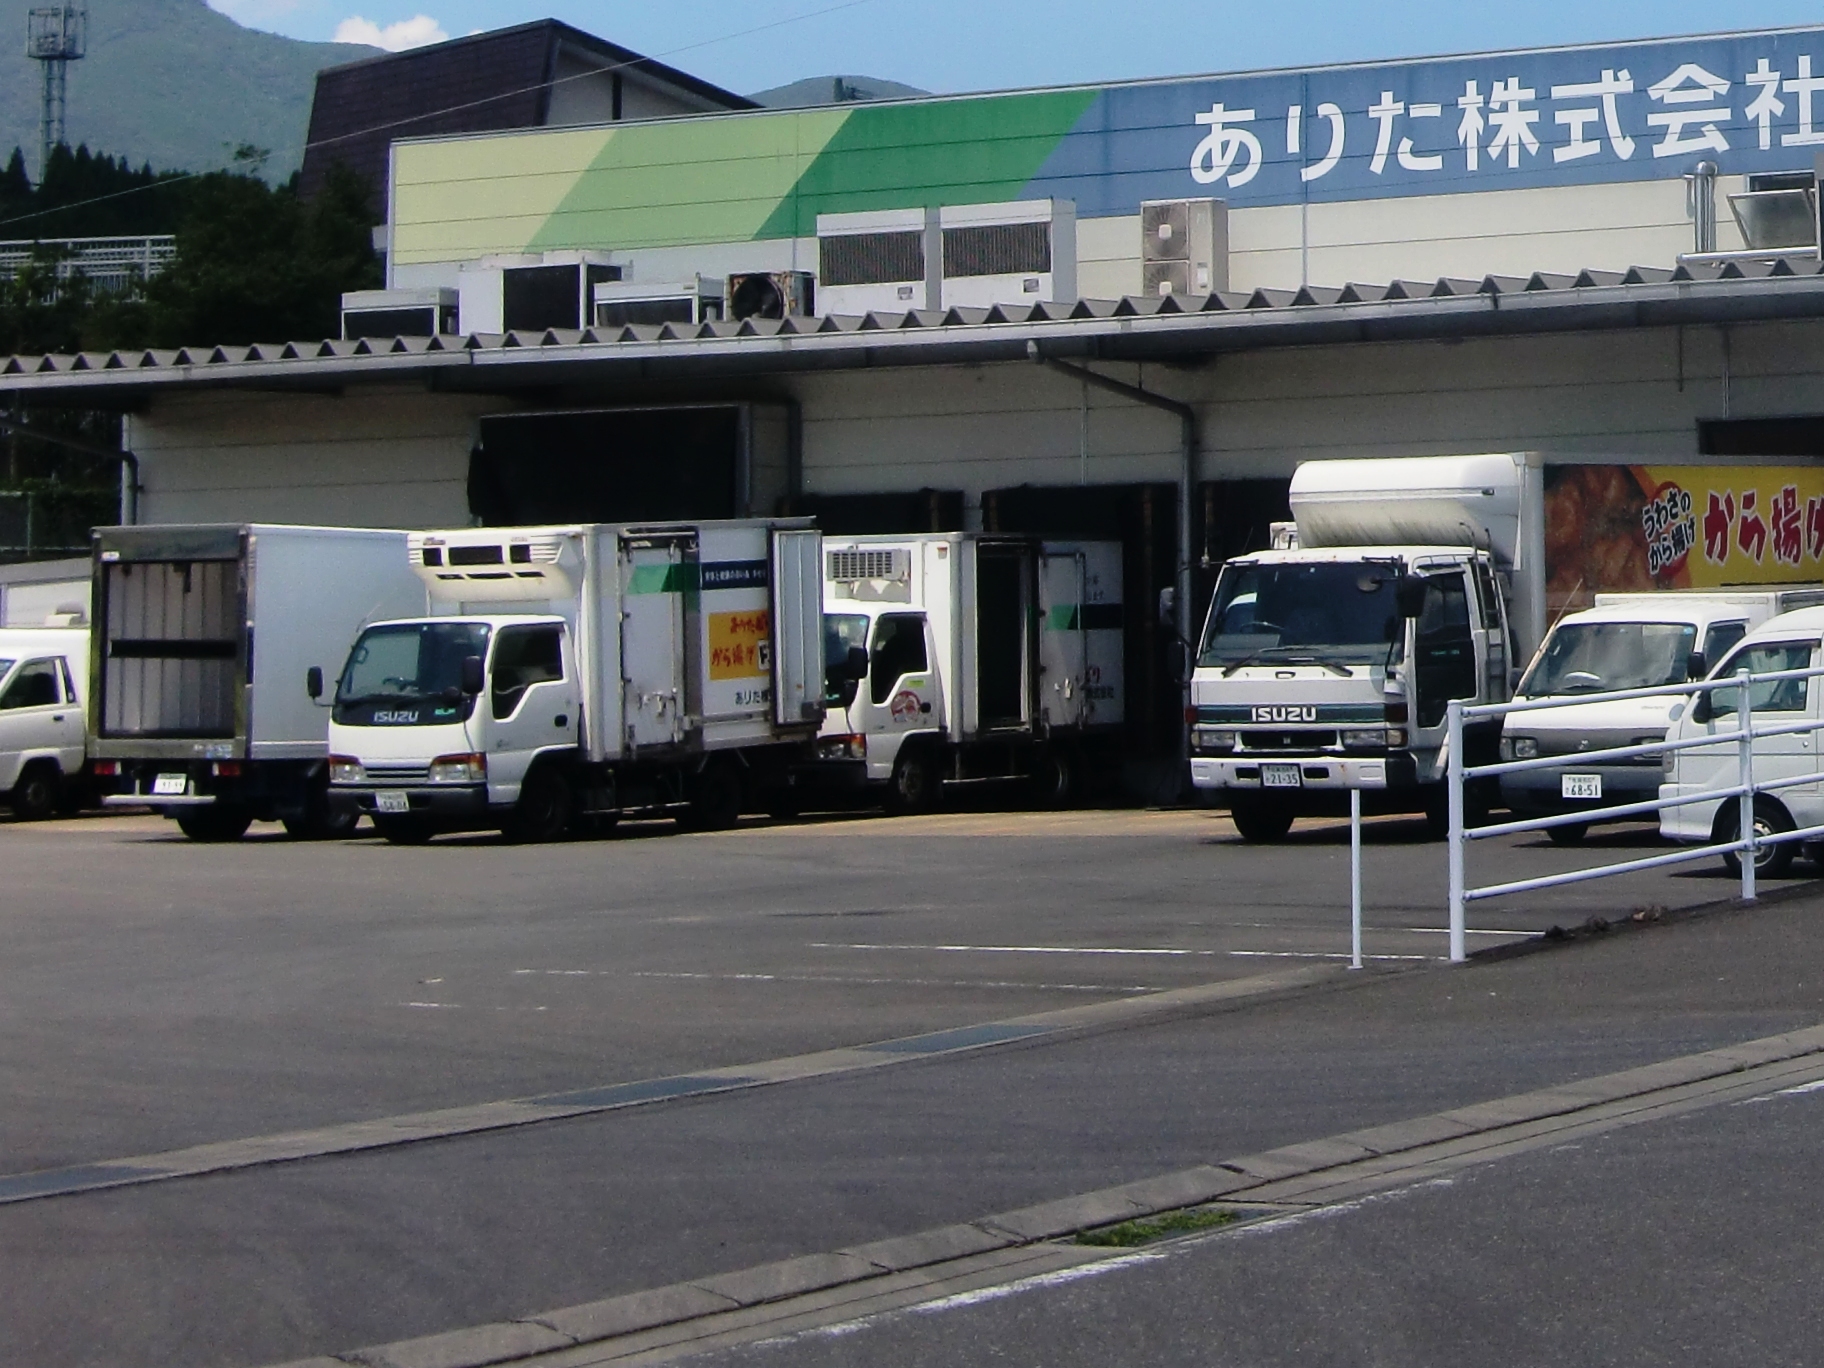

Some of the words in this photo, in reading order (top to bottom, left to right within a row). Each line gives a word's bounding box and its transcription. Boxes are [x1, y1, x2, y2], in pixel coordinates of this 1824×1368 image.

[1642, 488, 1692, 540] うわさの
[1648, 515, 1697, 574] から揚げ
[373, 711, 419, 722] ISUZU
[1251, 707, 1316, 722] ISUZU
